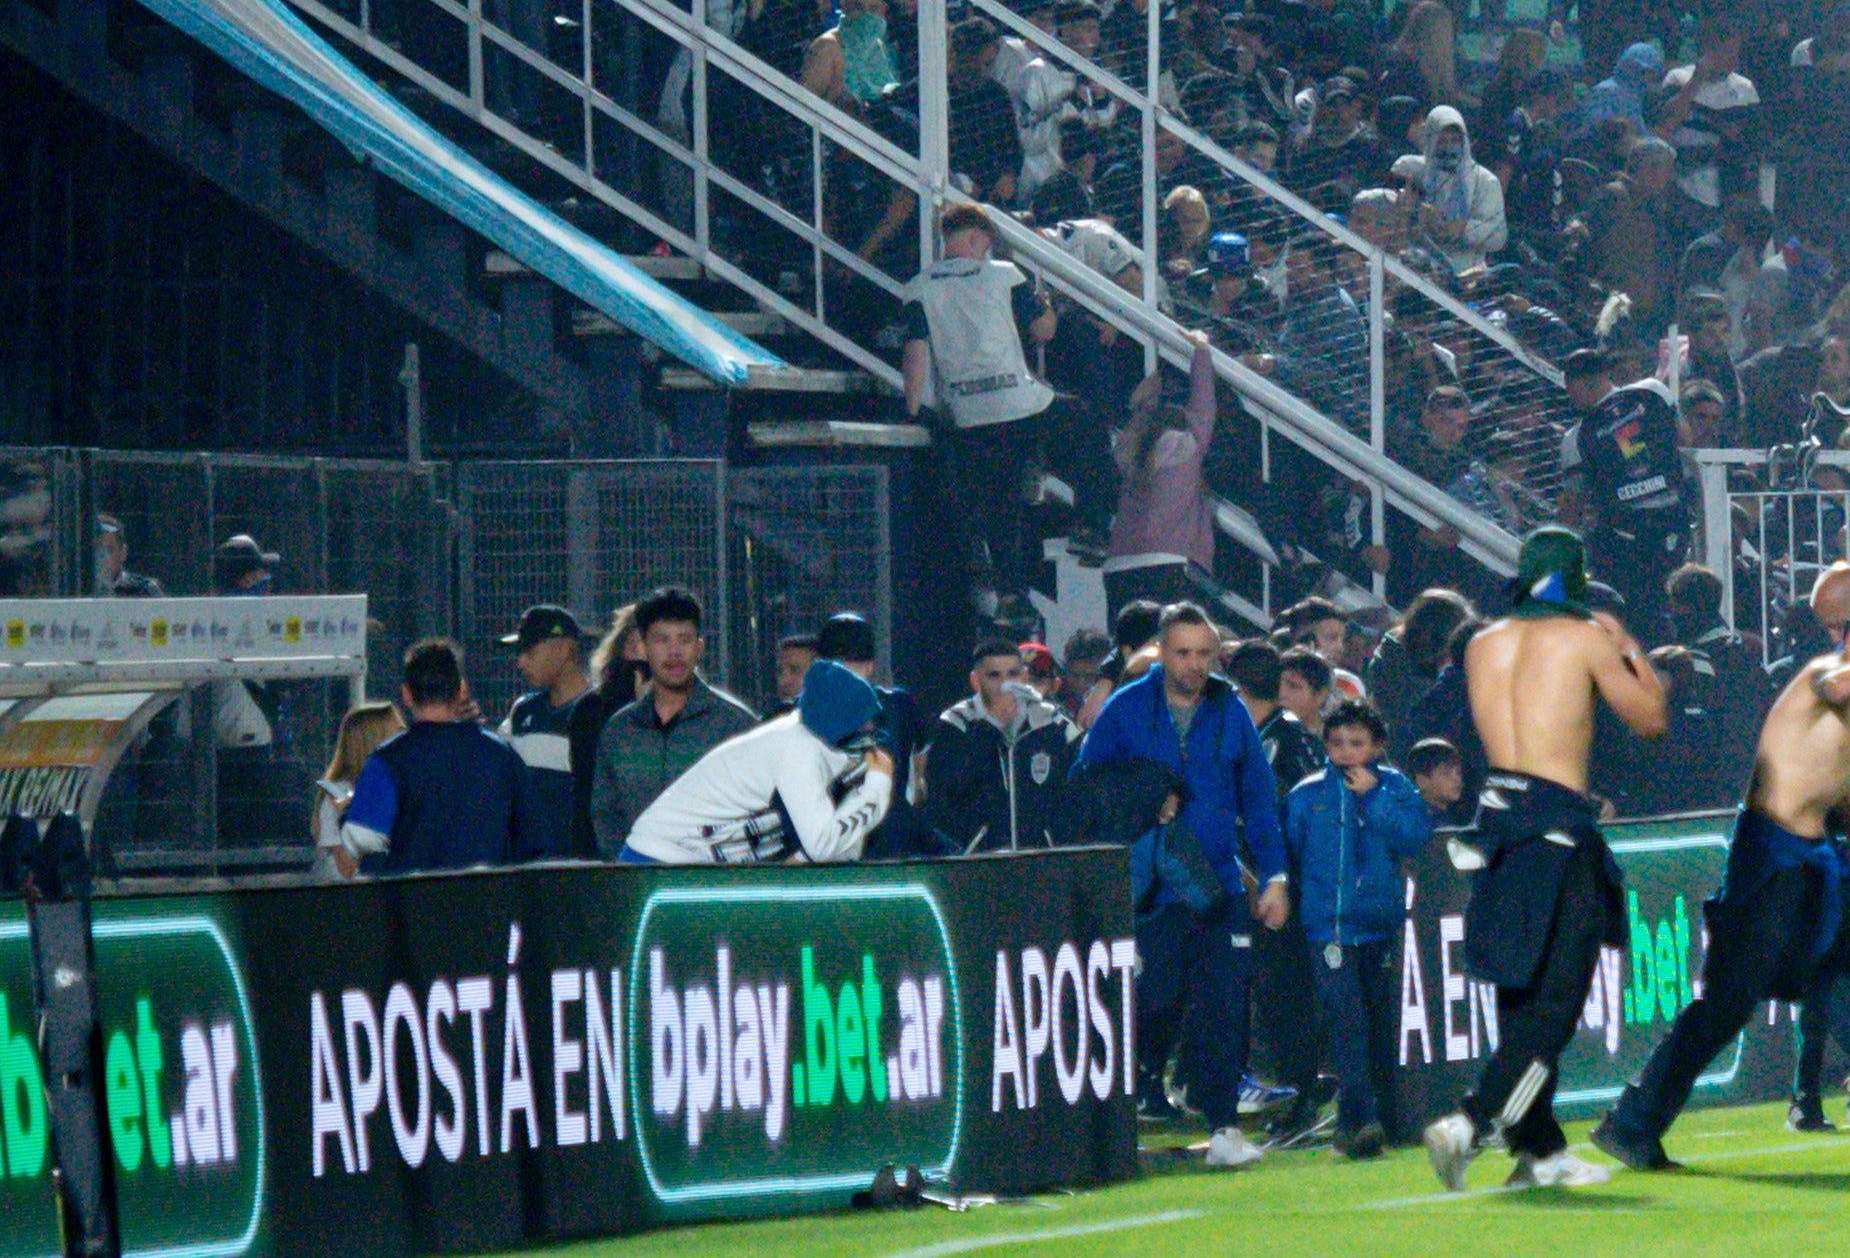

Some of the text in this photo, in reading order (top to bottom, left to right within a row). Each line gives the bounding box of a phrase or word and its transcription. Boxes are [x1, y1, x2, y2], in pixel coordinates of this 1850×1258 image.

[311, 922, 540, 1177] APOSTÁ
[550, 966, 627, 1147] EN
[649, 941, 944, 1147] bplay.bet.ar
